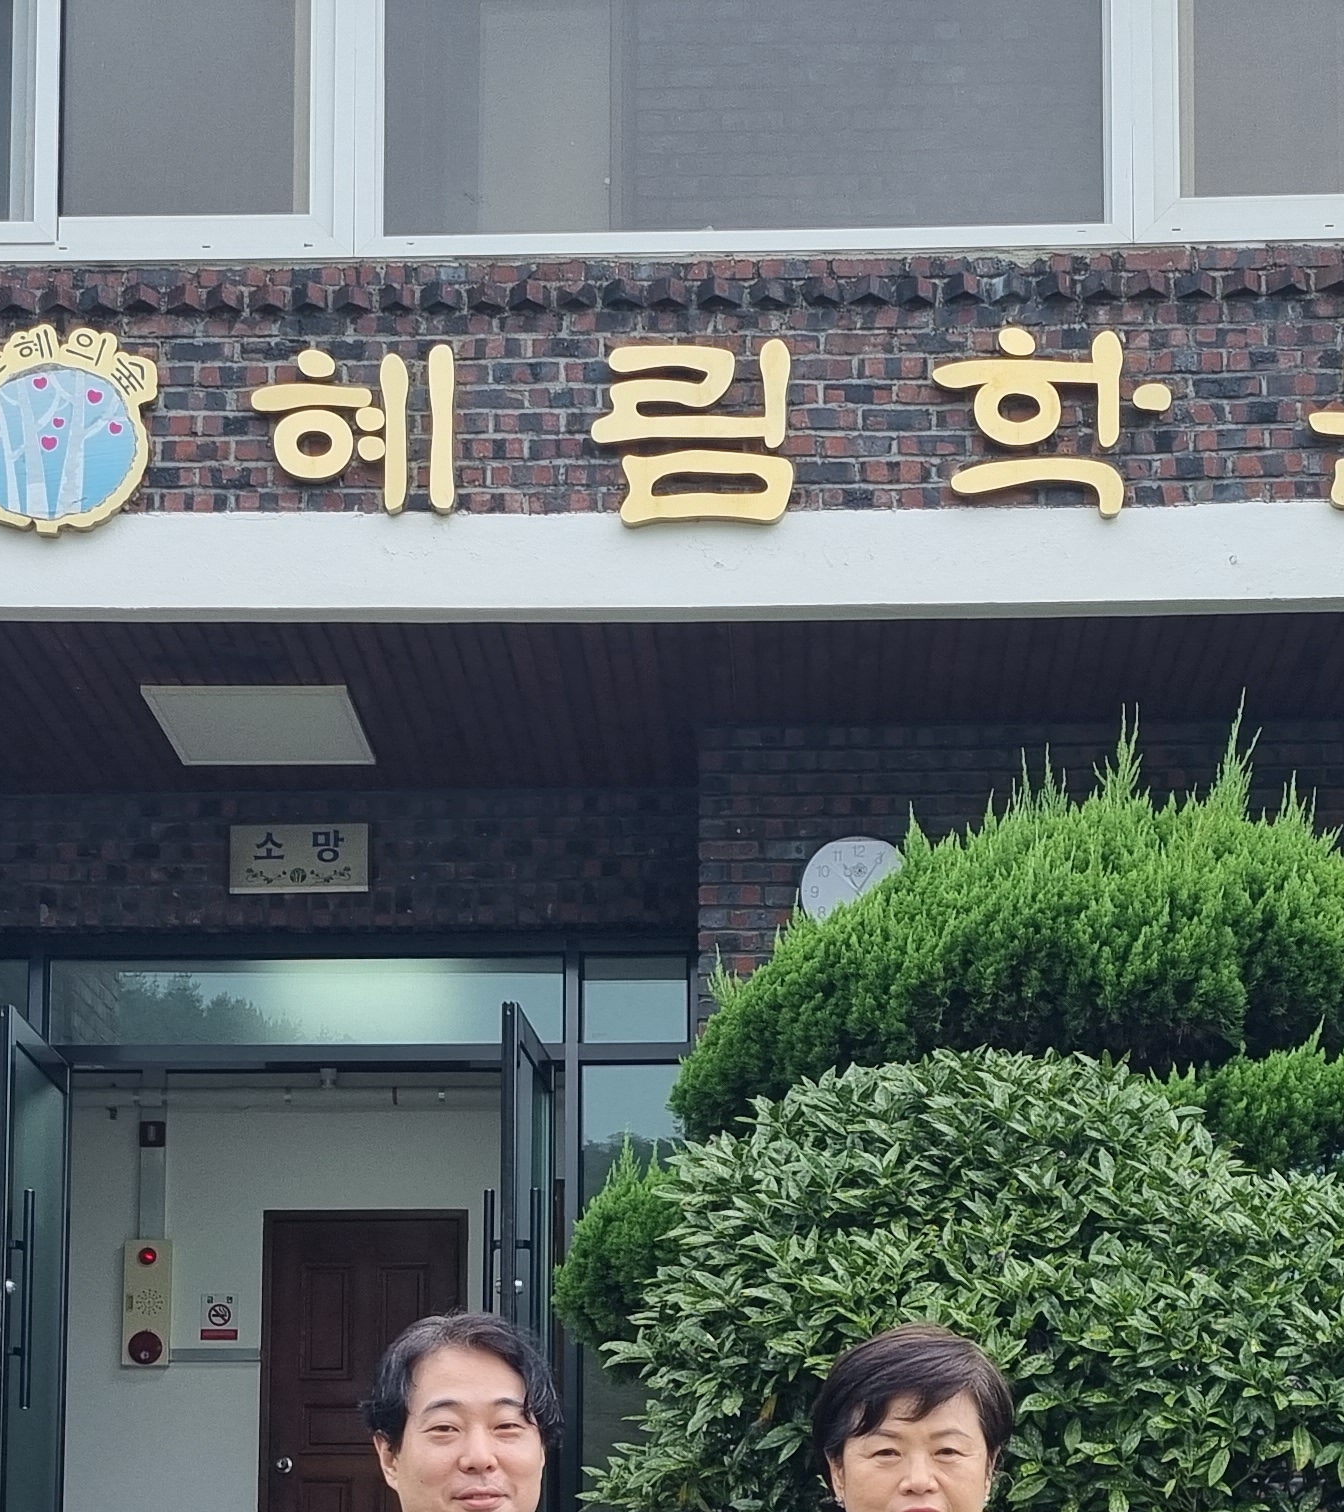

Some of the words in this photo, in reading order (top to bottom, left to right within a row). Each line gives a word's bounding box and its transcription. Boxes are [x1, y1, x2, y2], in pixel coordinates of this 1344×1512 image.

[833, 849, 843, 862] 11
[852, 844, 865, 858] 12
[816, 864, 830, 878] 10
[810, 885, 820, 898] 9
[817, 905, 826, 919] 8
